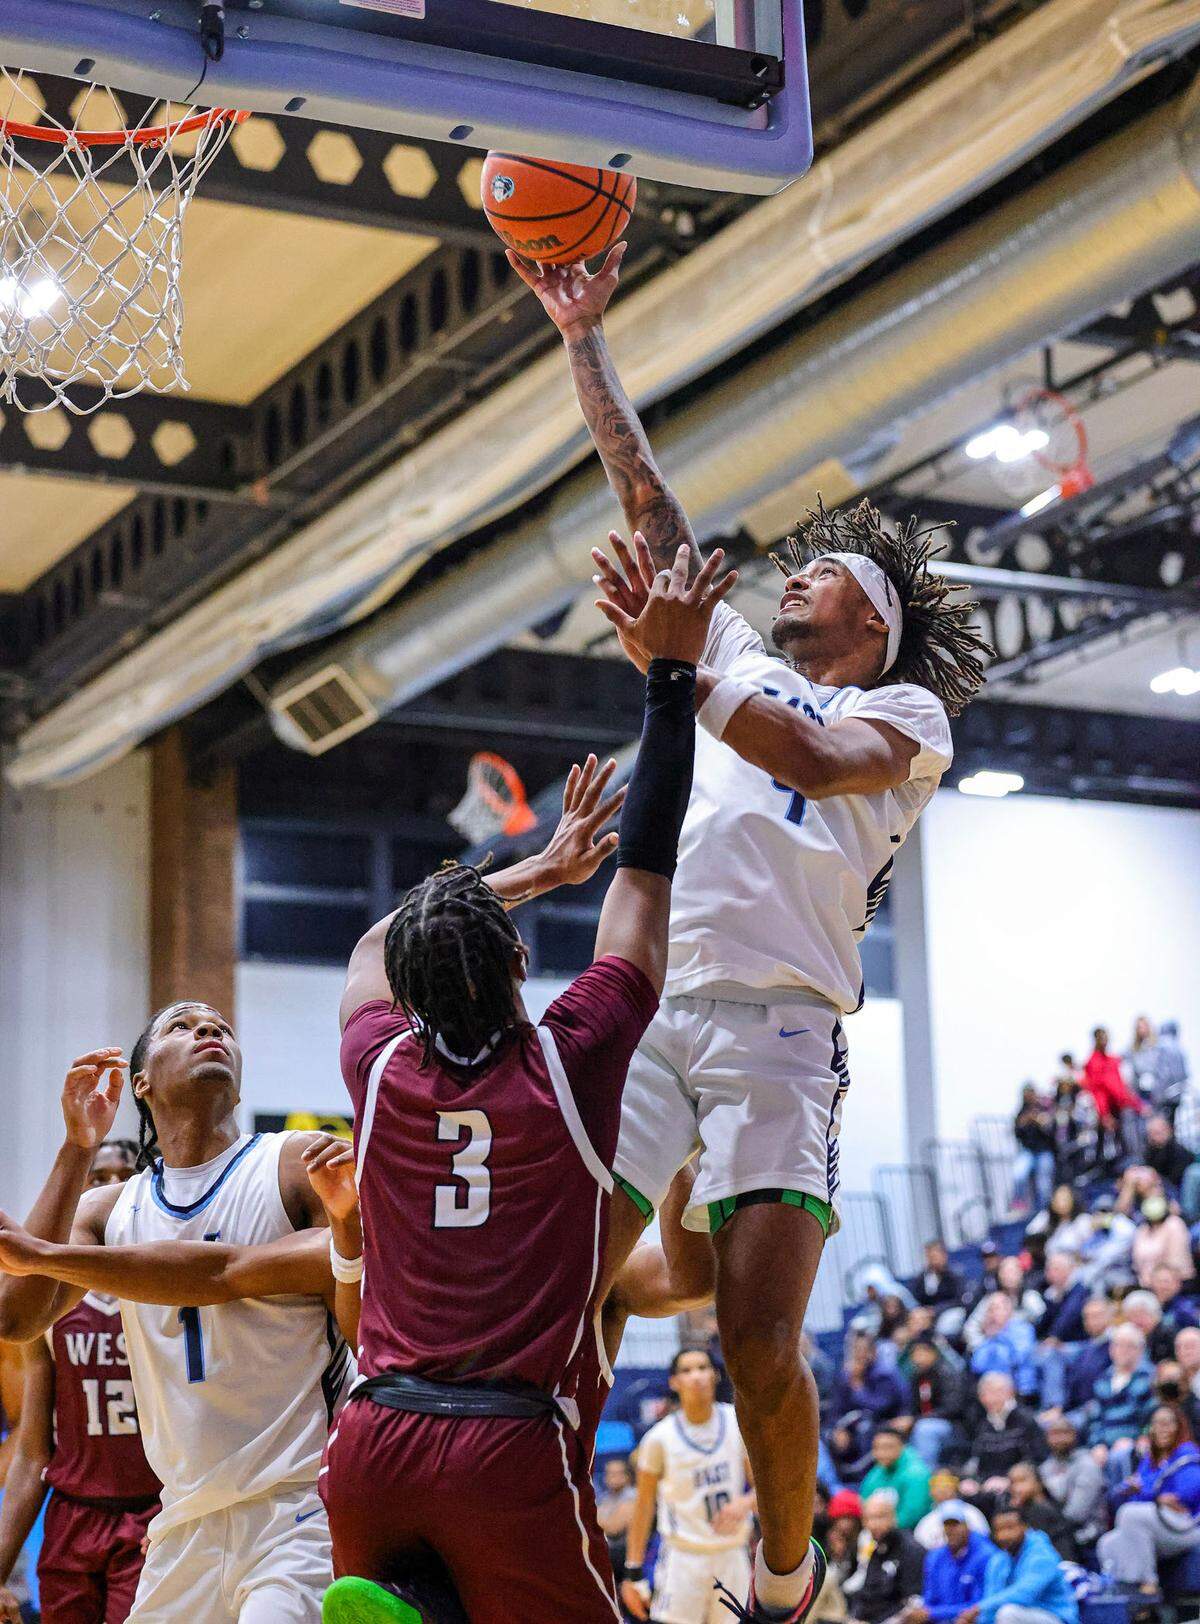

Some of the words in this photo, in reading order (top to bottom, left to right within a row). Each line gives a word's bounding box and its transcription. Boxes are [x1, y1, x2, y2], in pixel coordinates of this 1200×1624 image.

[433, 1108, 493, 1228] 3
[178, 1306, 206, 1384] 1
[81, 1378, 139, 1436] 12
